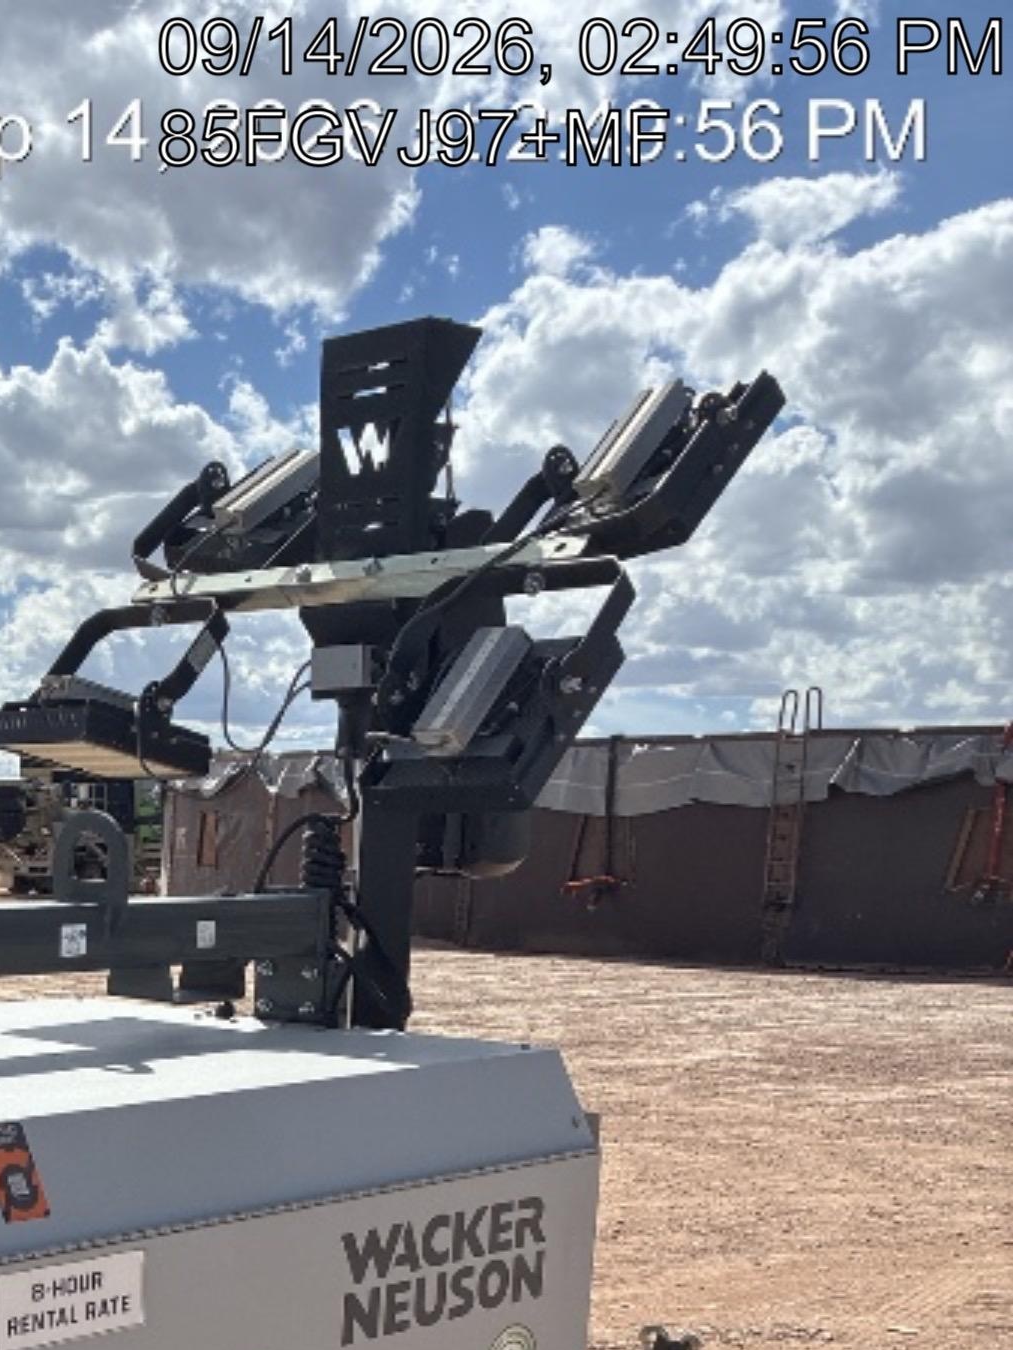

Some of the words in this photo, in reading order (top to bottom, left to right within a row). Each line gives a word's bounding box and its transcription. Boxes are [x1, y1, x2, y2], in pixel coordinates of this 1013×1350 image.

[341, 1196, 546, 1285] WACKER
[7, 1304, 79, 1338] RENTAL
[85, 1295, 131, 1322] RATE
[341, 1250, 545, 1348] NEUSON
